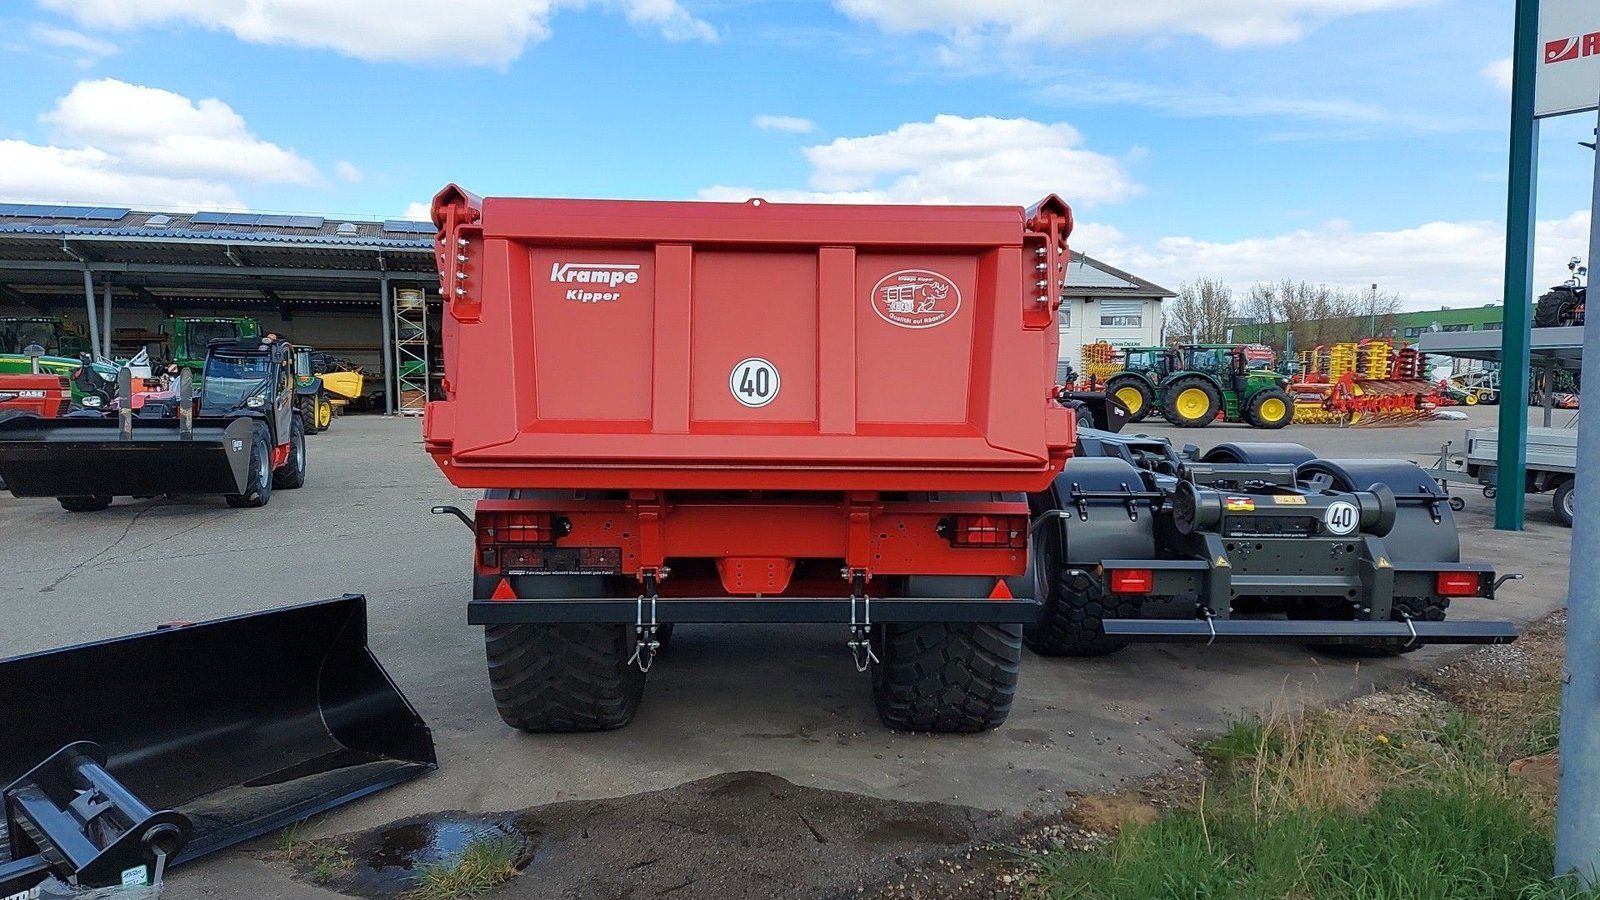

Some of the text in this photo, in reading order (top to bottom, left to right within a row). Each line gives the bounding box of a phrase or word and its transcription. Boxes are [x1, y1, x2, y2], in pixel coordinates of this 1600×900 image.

[550, 262, 640, 287] Krampe
[566, 289, 620, 303] Kipper
[739, 366, 770, 397] 40
[1331, 506, 1352, 528] 40
